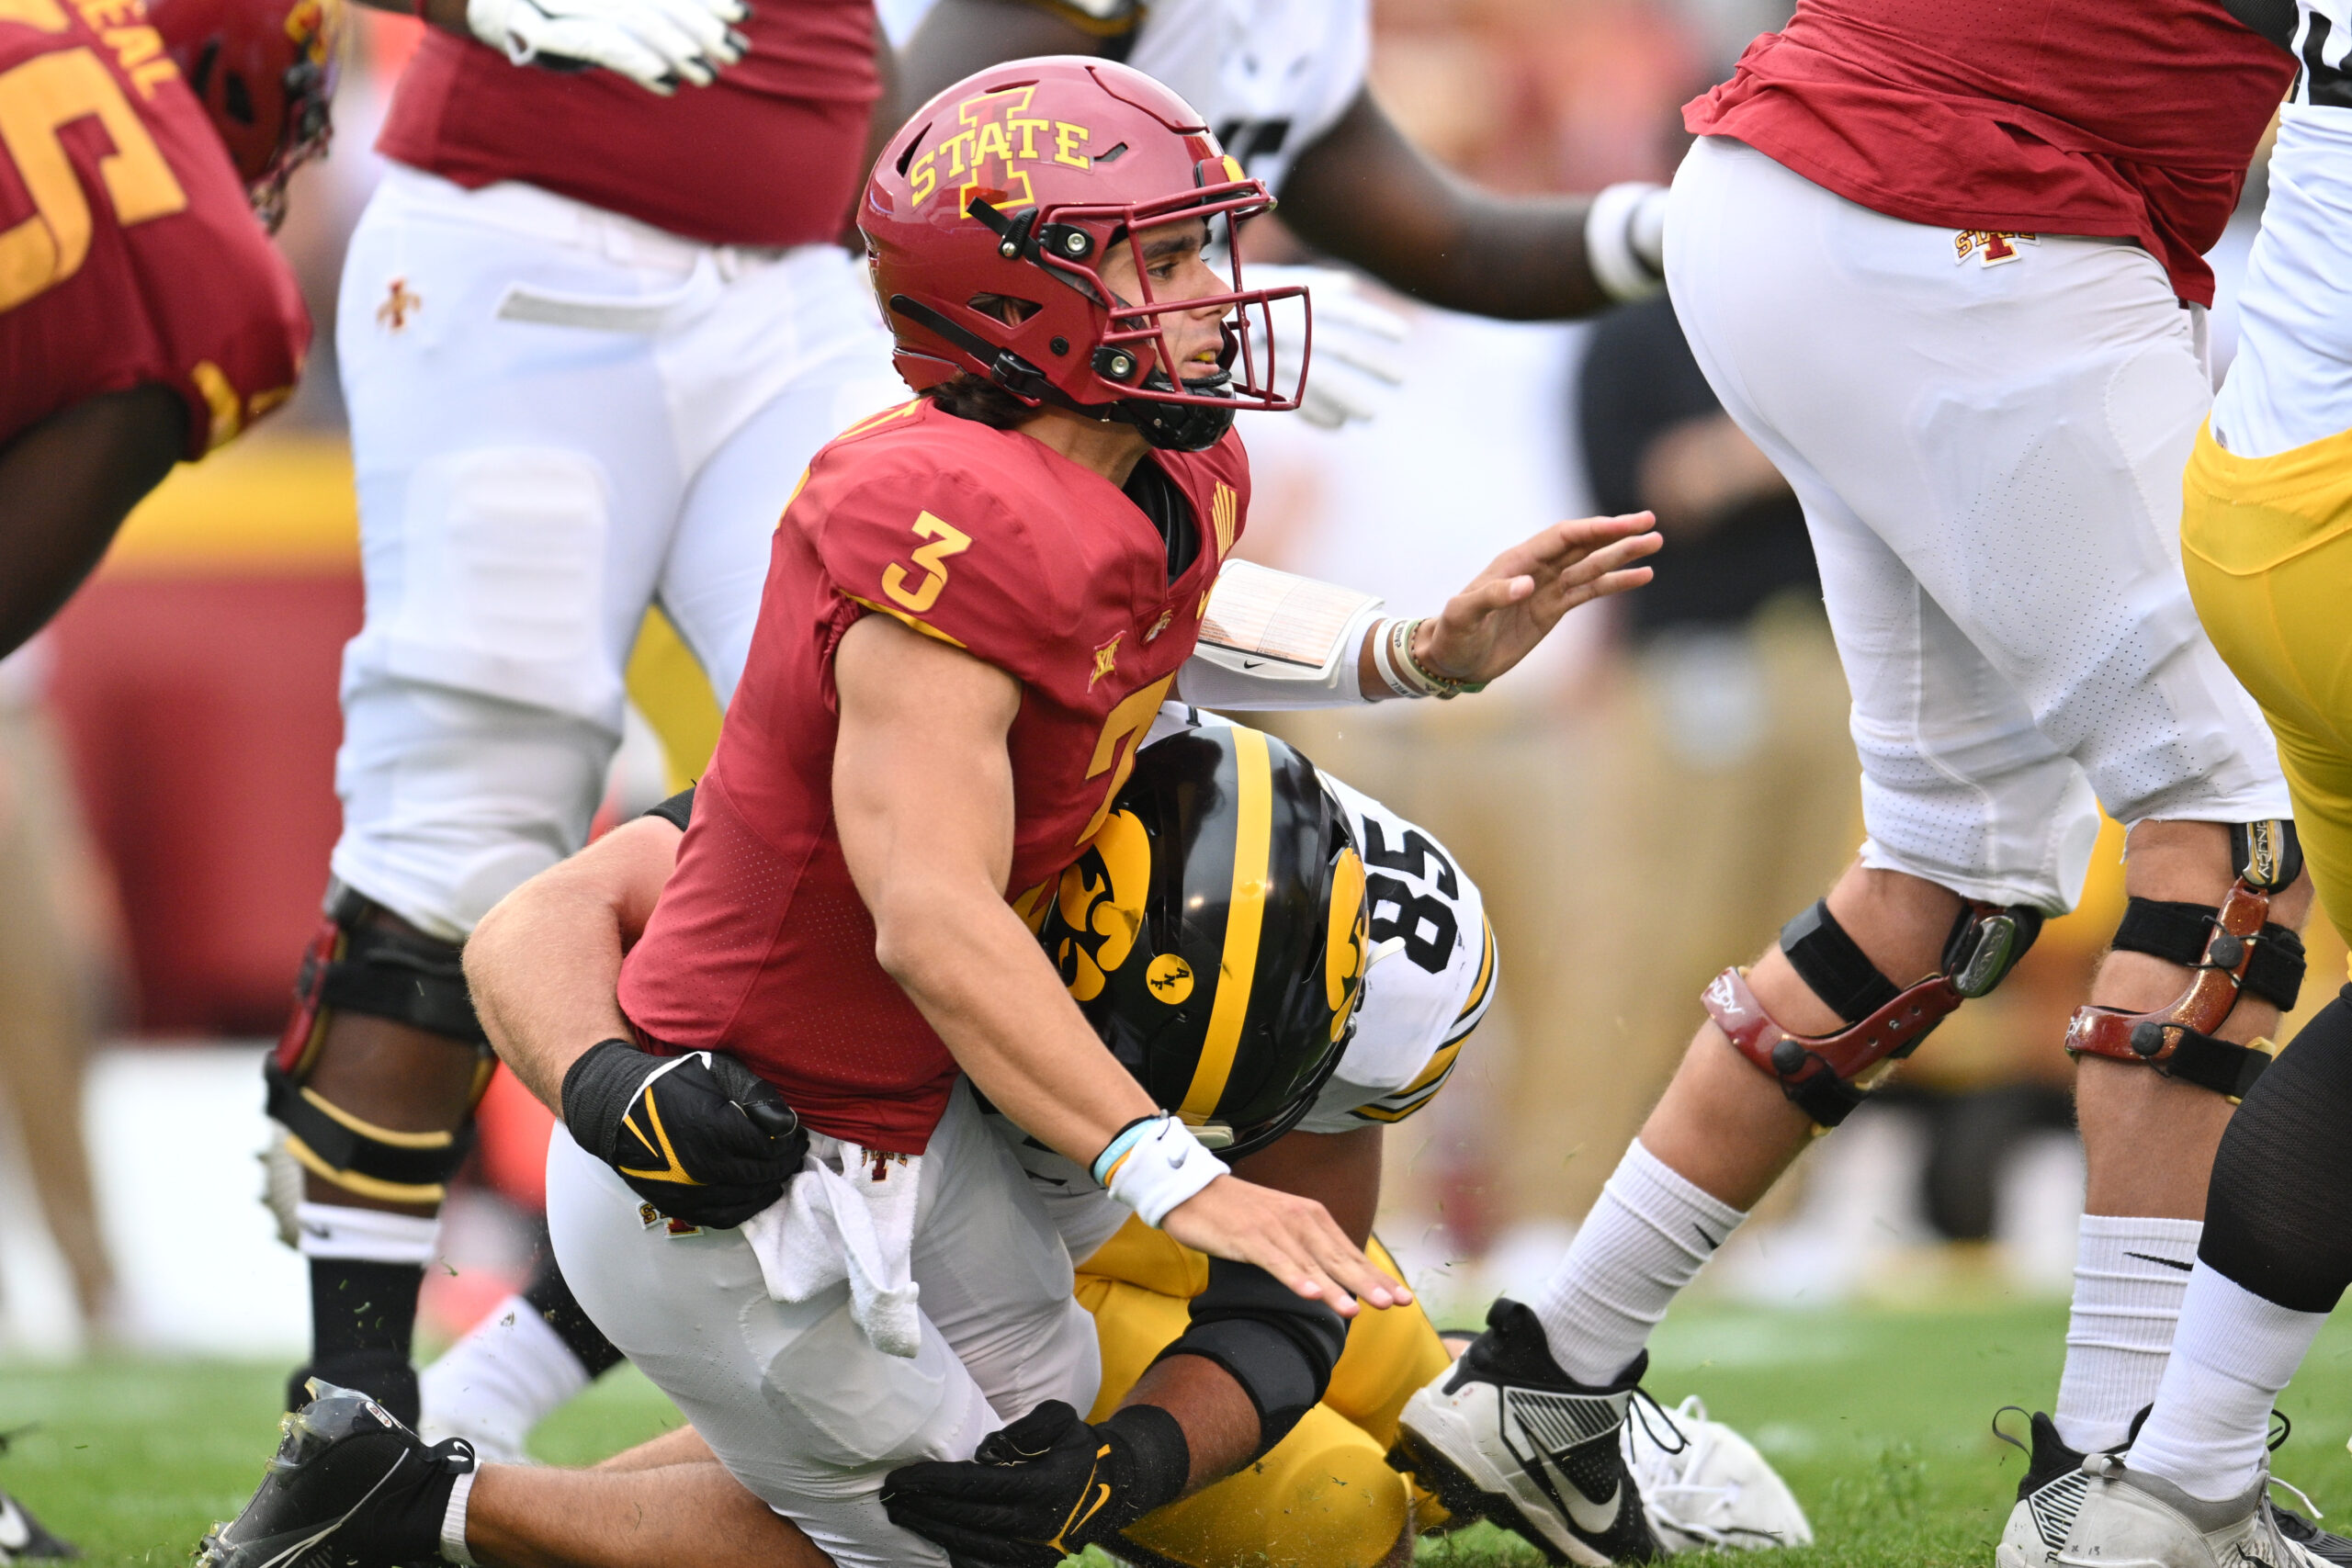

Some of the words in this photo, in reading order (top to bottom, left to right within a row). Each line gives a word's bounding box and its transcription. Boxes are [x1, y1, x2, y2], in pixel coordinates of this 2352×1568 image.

[910, 118, 1091, 208] STATE
[881, 510, 973, 613] 3
[1361, 813, 1459, 975] 85
